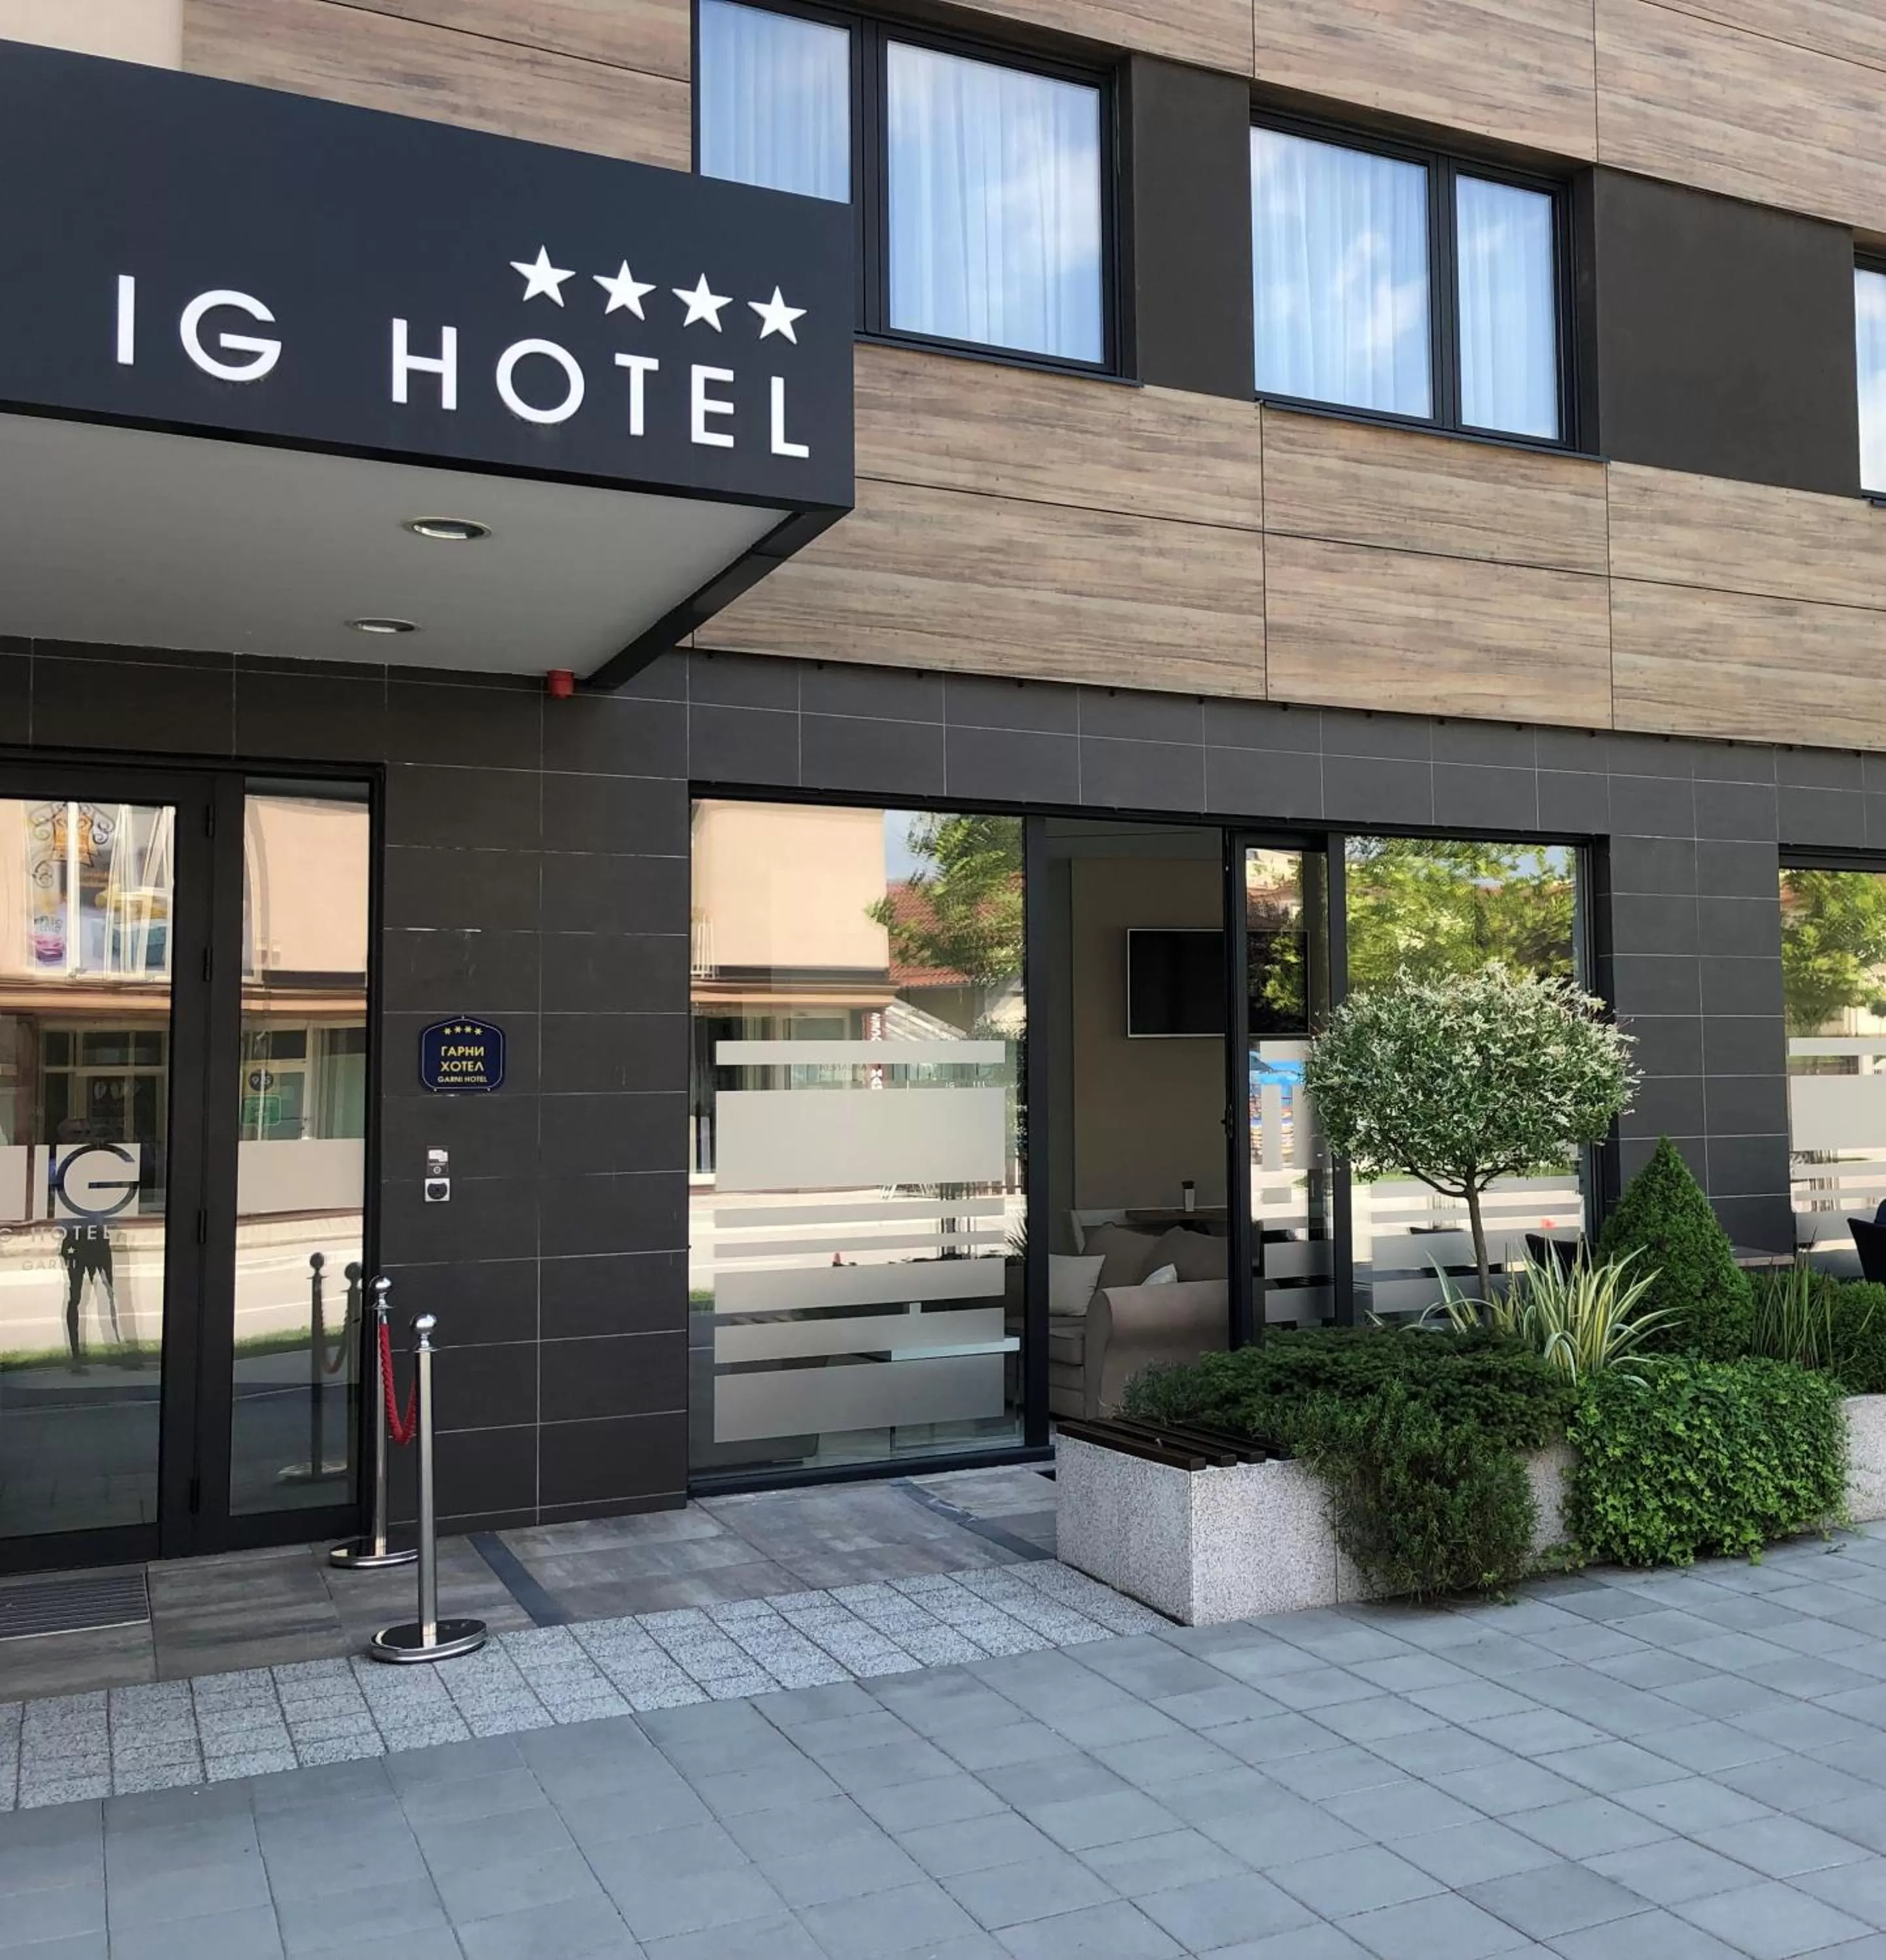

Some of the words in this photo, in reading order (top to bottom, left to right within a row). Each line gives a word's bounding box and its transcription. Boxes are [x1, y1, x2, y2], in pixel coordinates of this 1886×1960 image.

[117, 274, 282, 382] IG
[392, 318, 809, 458] HOTEL
[441, 1046, 484, 1056] ГАРНИ
[440, 1060, 484, 1072] ХОТЕЛ
[31, 1224, 110, 1242] HOTEL
